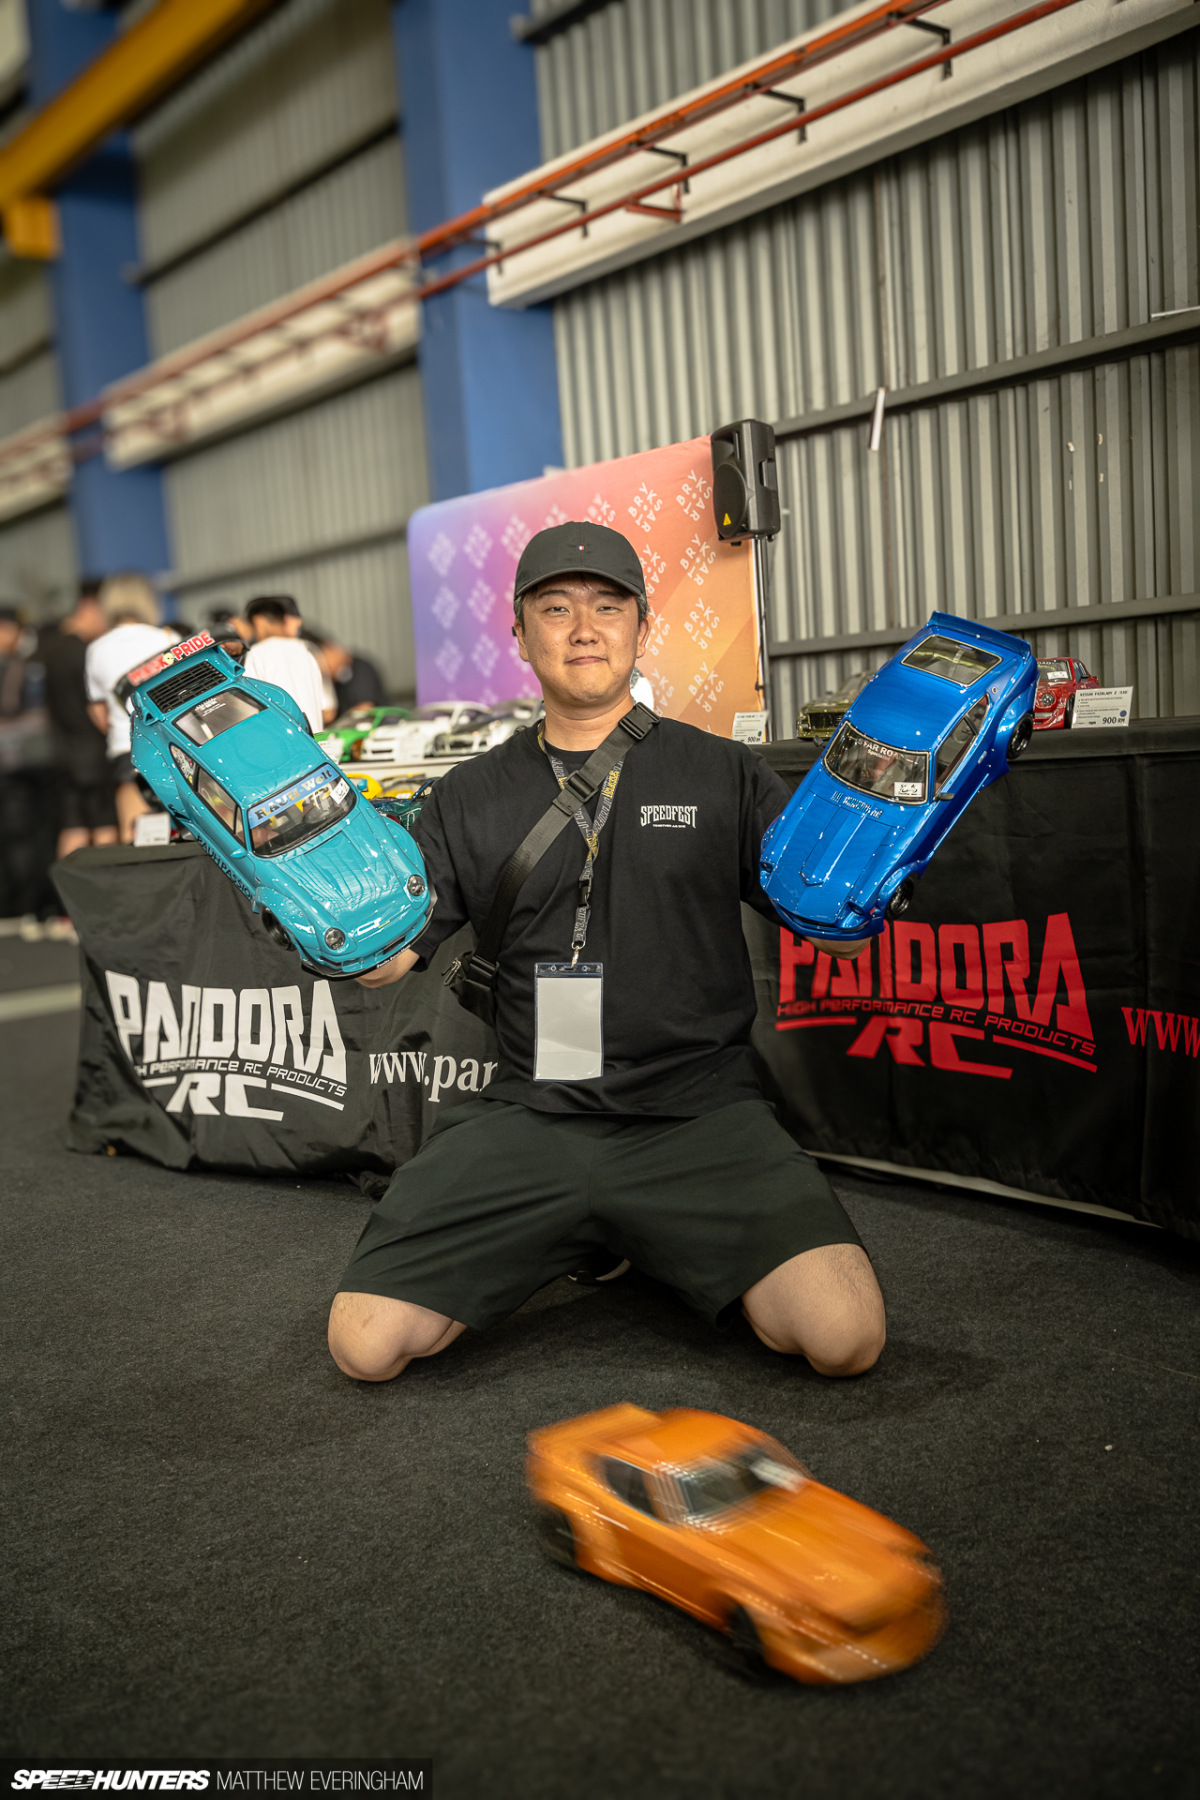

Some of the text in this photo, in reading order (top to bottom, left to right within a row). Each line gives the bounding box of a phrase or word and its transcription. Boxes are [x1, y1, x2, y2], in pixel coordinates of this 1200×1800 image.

[171, 630, 215, 660] PRIDE
[1102, 716, 1117, 724] 900
[880, 746, 903, 759] ROA
[254, 769, 333, 820] RAUH-Welt
[640, 804, 698, 829] SPEEDFEST
[779, 912, 1095, 1041] PANDORA
[105, 970, 347, 1084] PANDORA
[820, 998, 944, 1018] PERFORMANCE
[949, 1008, 977, 1024] RC
[984, 1014, 1097, 1056] PRODUCTS
[847, 1016, 1013, 1079] RC
[165, 1073, 284, 1121] RC
[243, 1061, 263, 1075] RC
[266, 1065, 348, 1097] PRODUCTS
